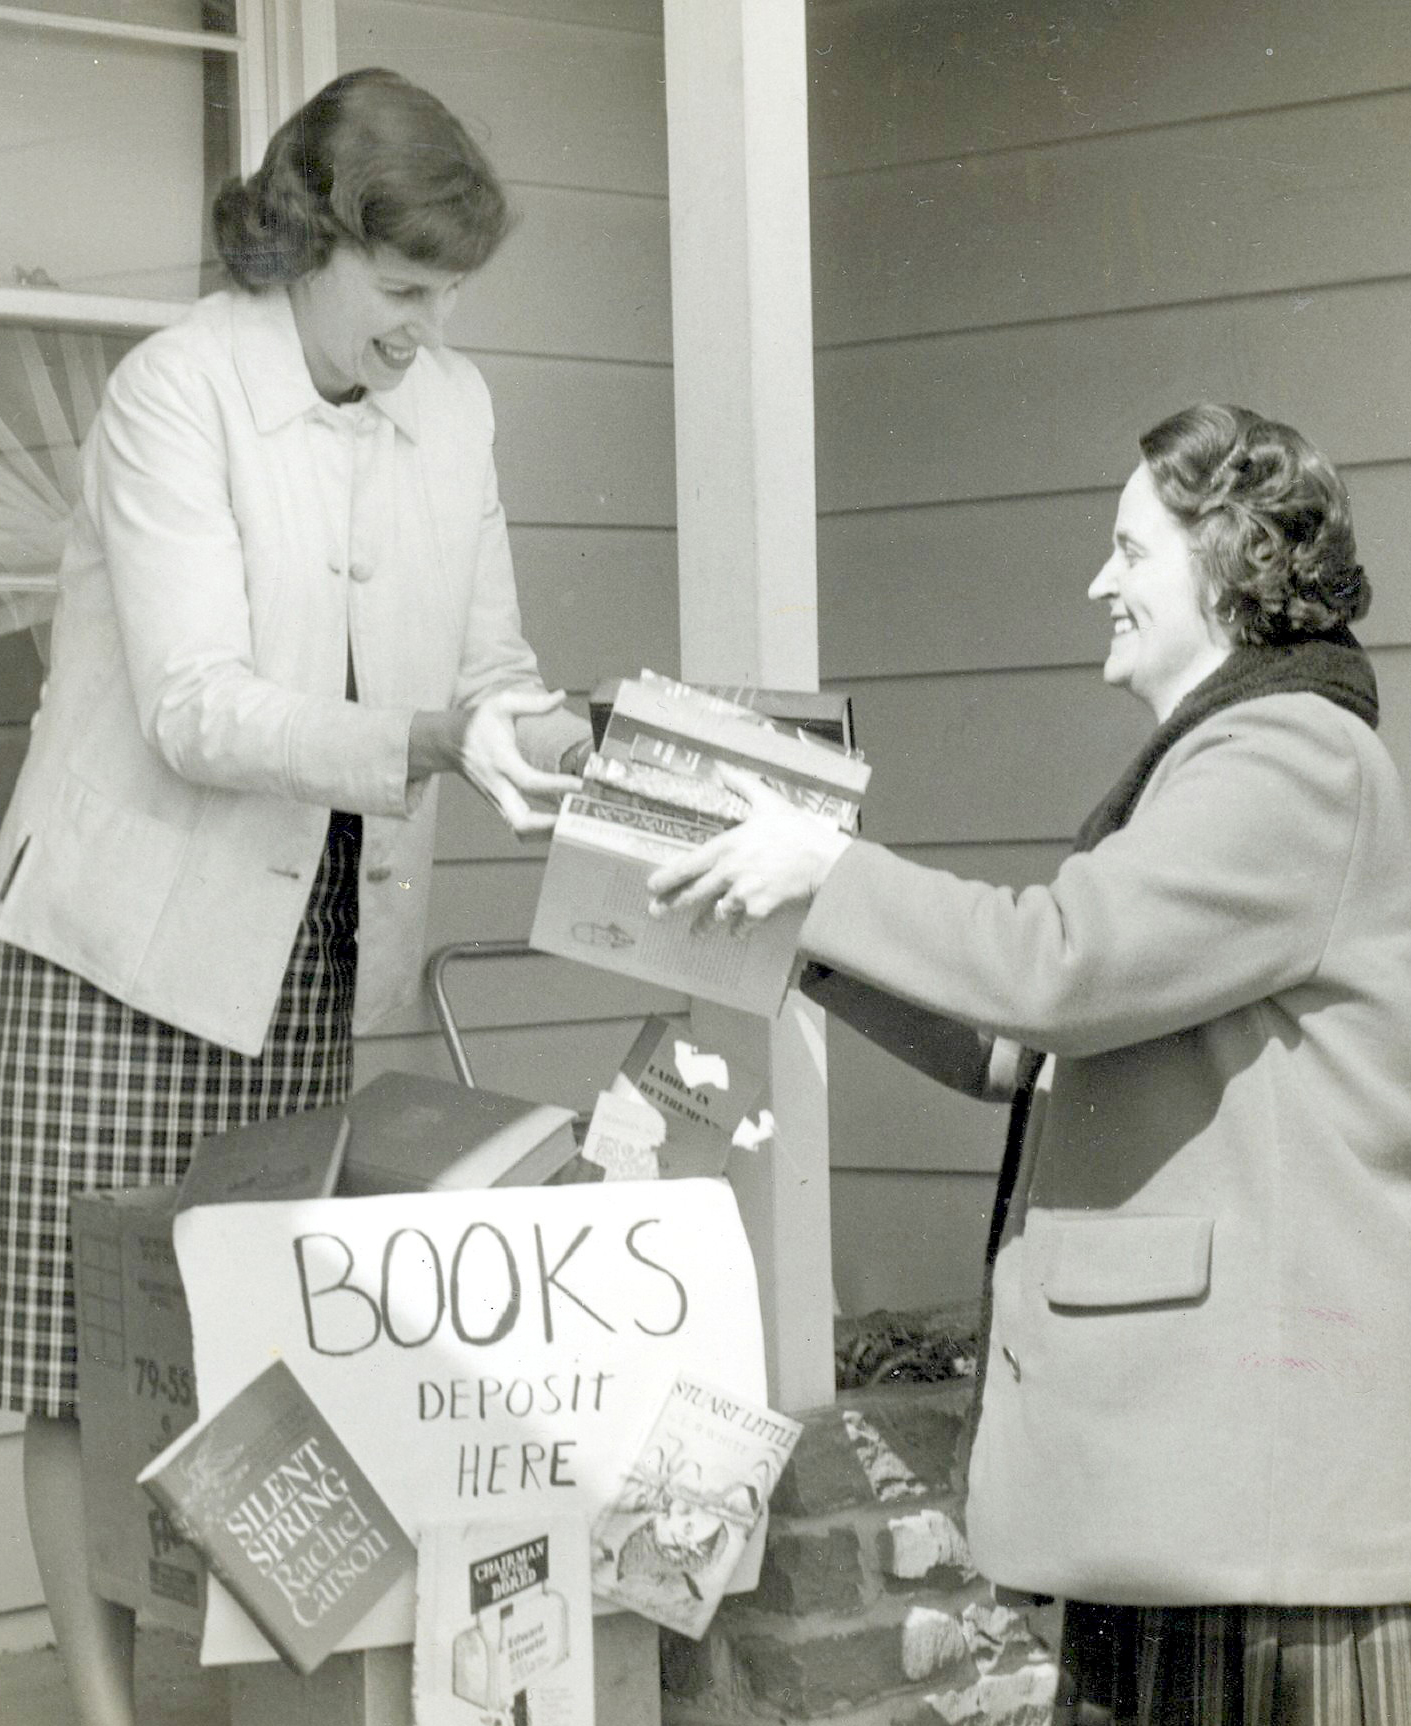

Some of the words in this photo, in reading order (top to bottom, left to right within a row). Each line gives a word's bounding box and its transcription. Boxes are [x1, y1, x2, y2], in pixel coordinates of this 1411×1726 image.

[293, 1218, 688, 1356] BOOKS
[671, 1381, 745, 1421] STUART
[741, 1411, 798, 1450] LITTLE
[226, 1437, 325, 1547] SILENT
[457, 1440, 578, 1498] HERE
[247, 1467, 349, 1578] SPRING
[270, 1495, 370, 1603] Rachel
[474, 1541, 546, 1583] CHAIRMAN
[291, 1528, 391, 1628] Carson
[492, 1568, 537, 1600] BORED
